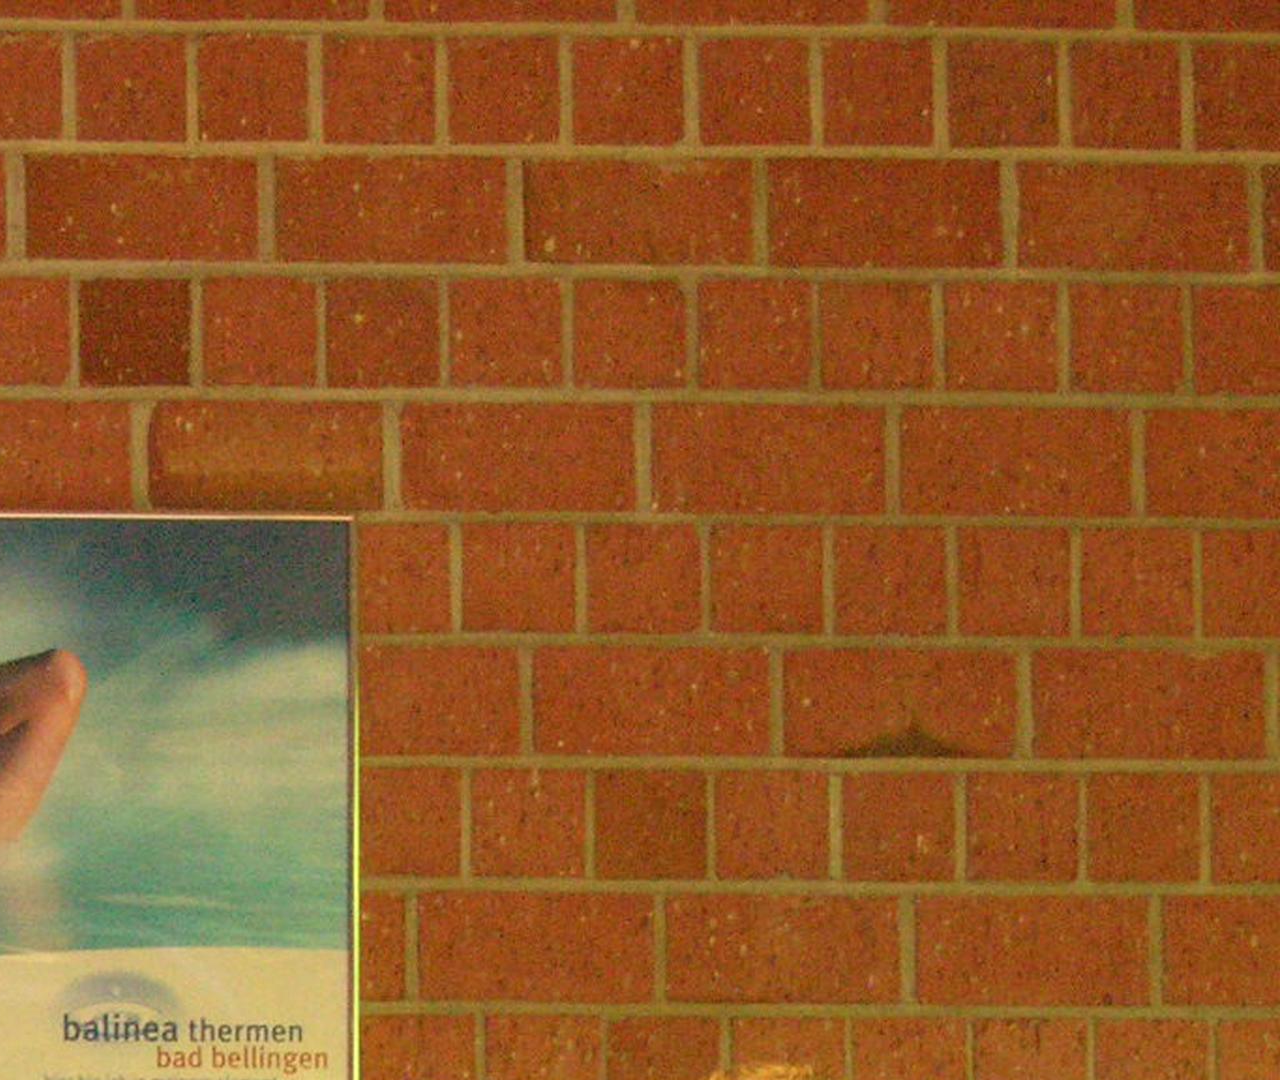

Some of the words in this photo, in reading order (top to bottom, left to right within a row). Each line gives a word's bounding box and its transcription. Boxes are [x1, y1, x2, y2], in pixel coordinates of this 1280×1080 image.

[63, 1014, 178, 1042] balinea
[189, 1018, 303, 1042] thermen
[156, 1046, 202, 1068] bad
[212, 1047, 329, 1075] bellingen
